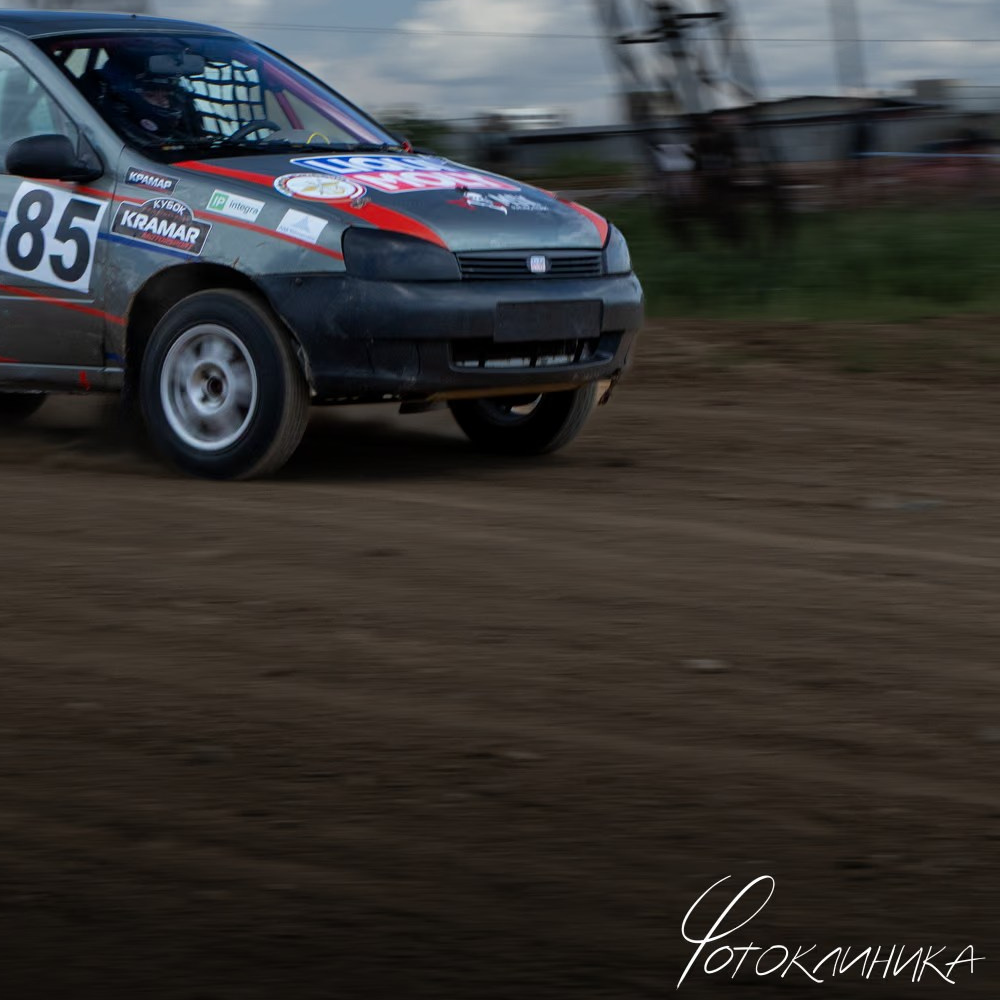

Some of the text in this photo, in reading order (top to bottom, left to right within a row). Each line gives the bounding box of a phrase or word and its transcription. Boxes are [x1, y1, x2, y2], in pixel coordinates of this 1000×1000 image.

[153, 200, 187, 216] КУБОК
[6, 189, 102, 282] 85
[120, 210, 200, 244] KRAMAR
